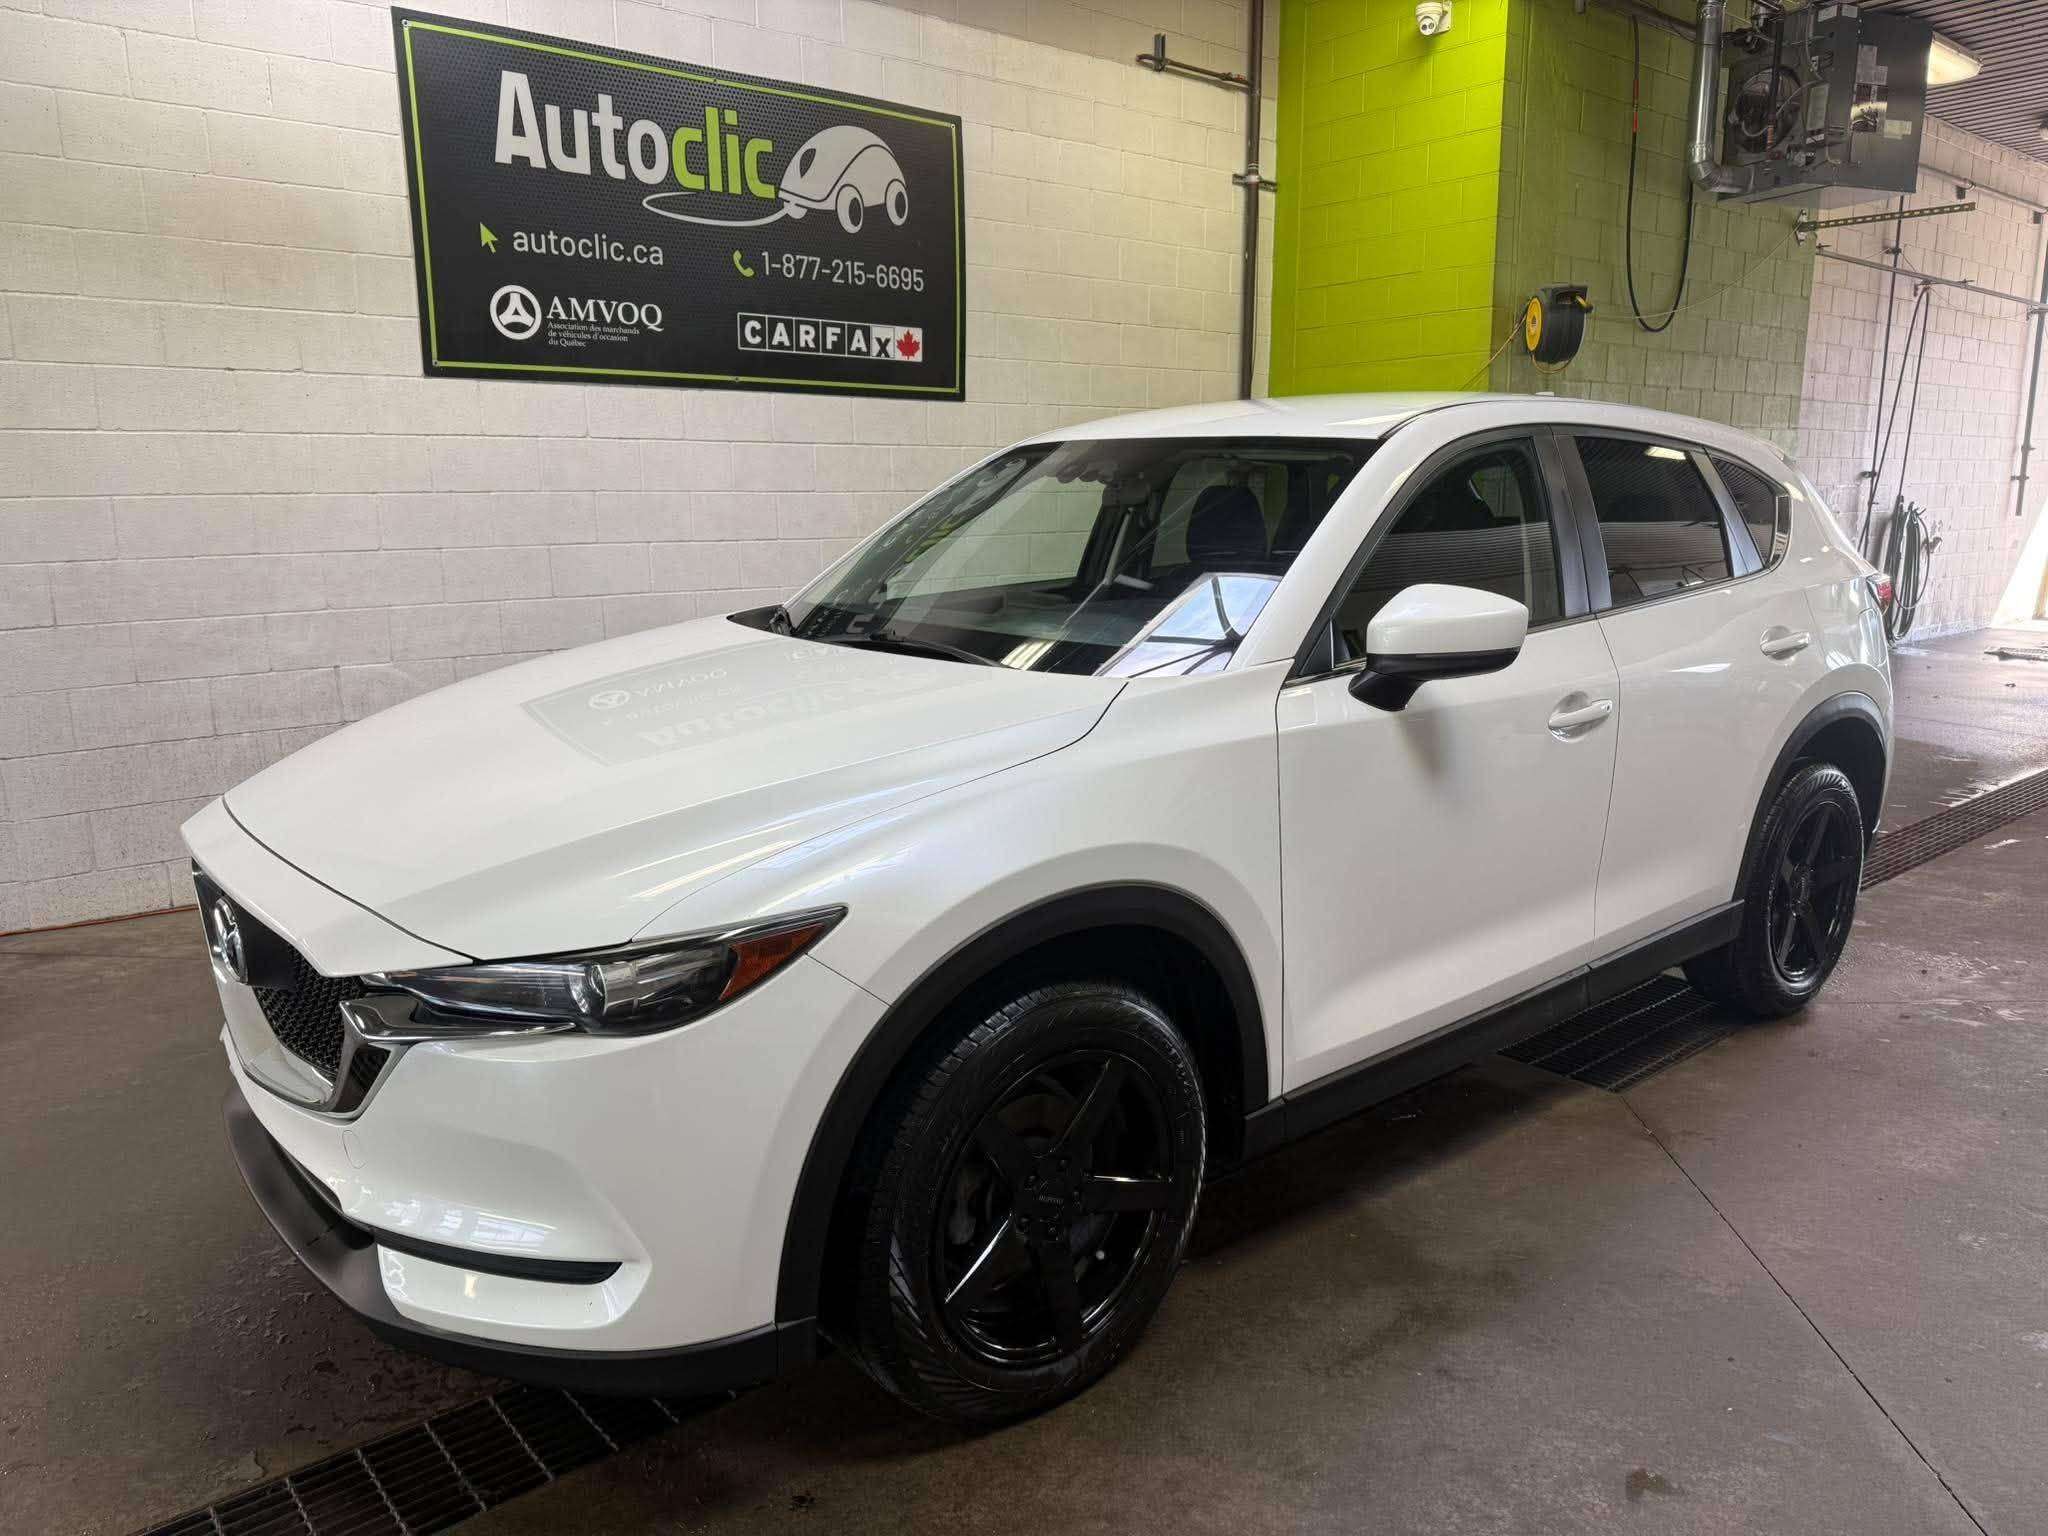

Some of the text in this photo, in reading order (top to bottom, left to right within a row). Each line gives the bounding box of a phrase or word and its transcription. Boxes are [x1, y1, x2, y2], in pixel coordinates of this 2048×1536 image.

[495, 70, 775, 199] Autoclic
[513, 230, 664, 266] autoclic.ca
[762, 251, 924, 292] 1-877-215-6695
[546, 295, 664, 332] AMVOQ
[548, 322, 589, 332] Association
[602, 326, 640, 335] marchands
[558, 330, 591, 340] véhicules
[560, 339, 587, 348] Québec
[744, 319, 891, 358] CARFAX
